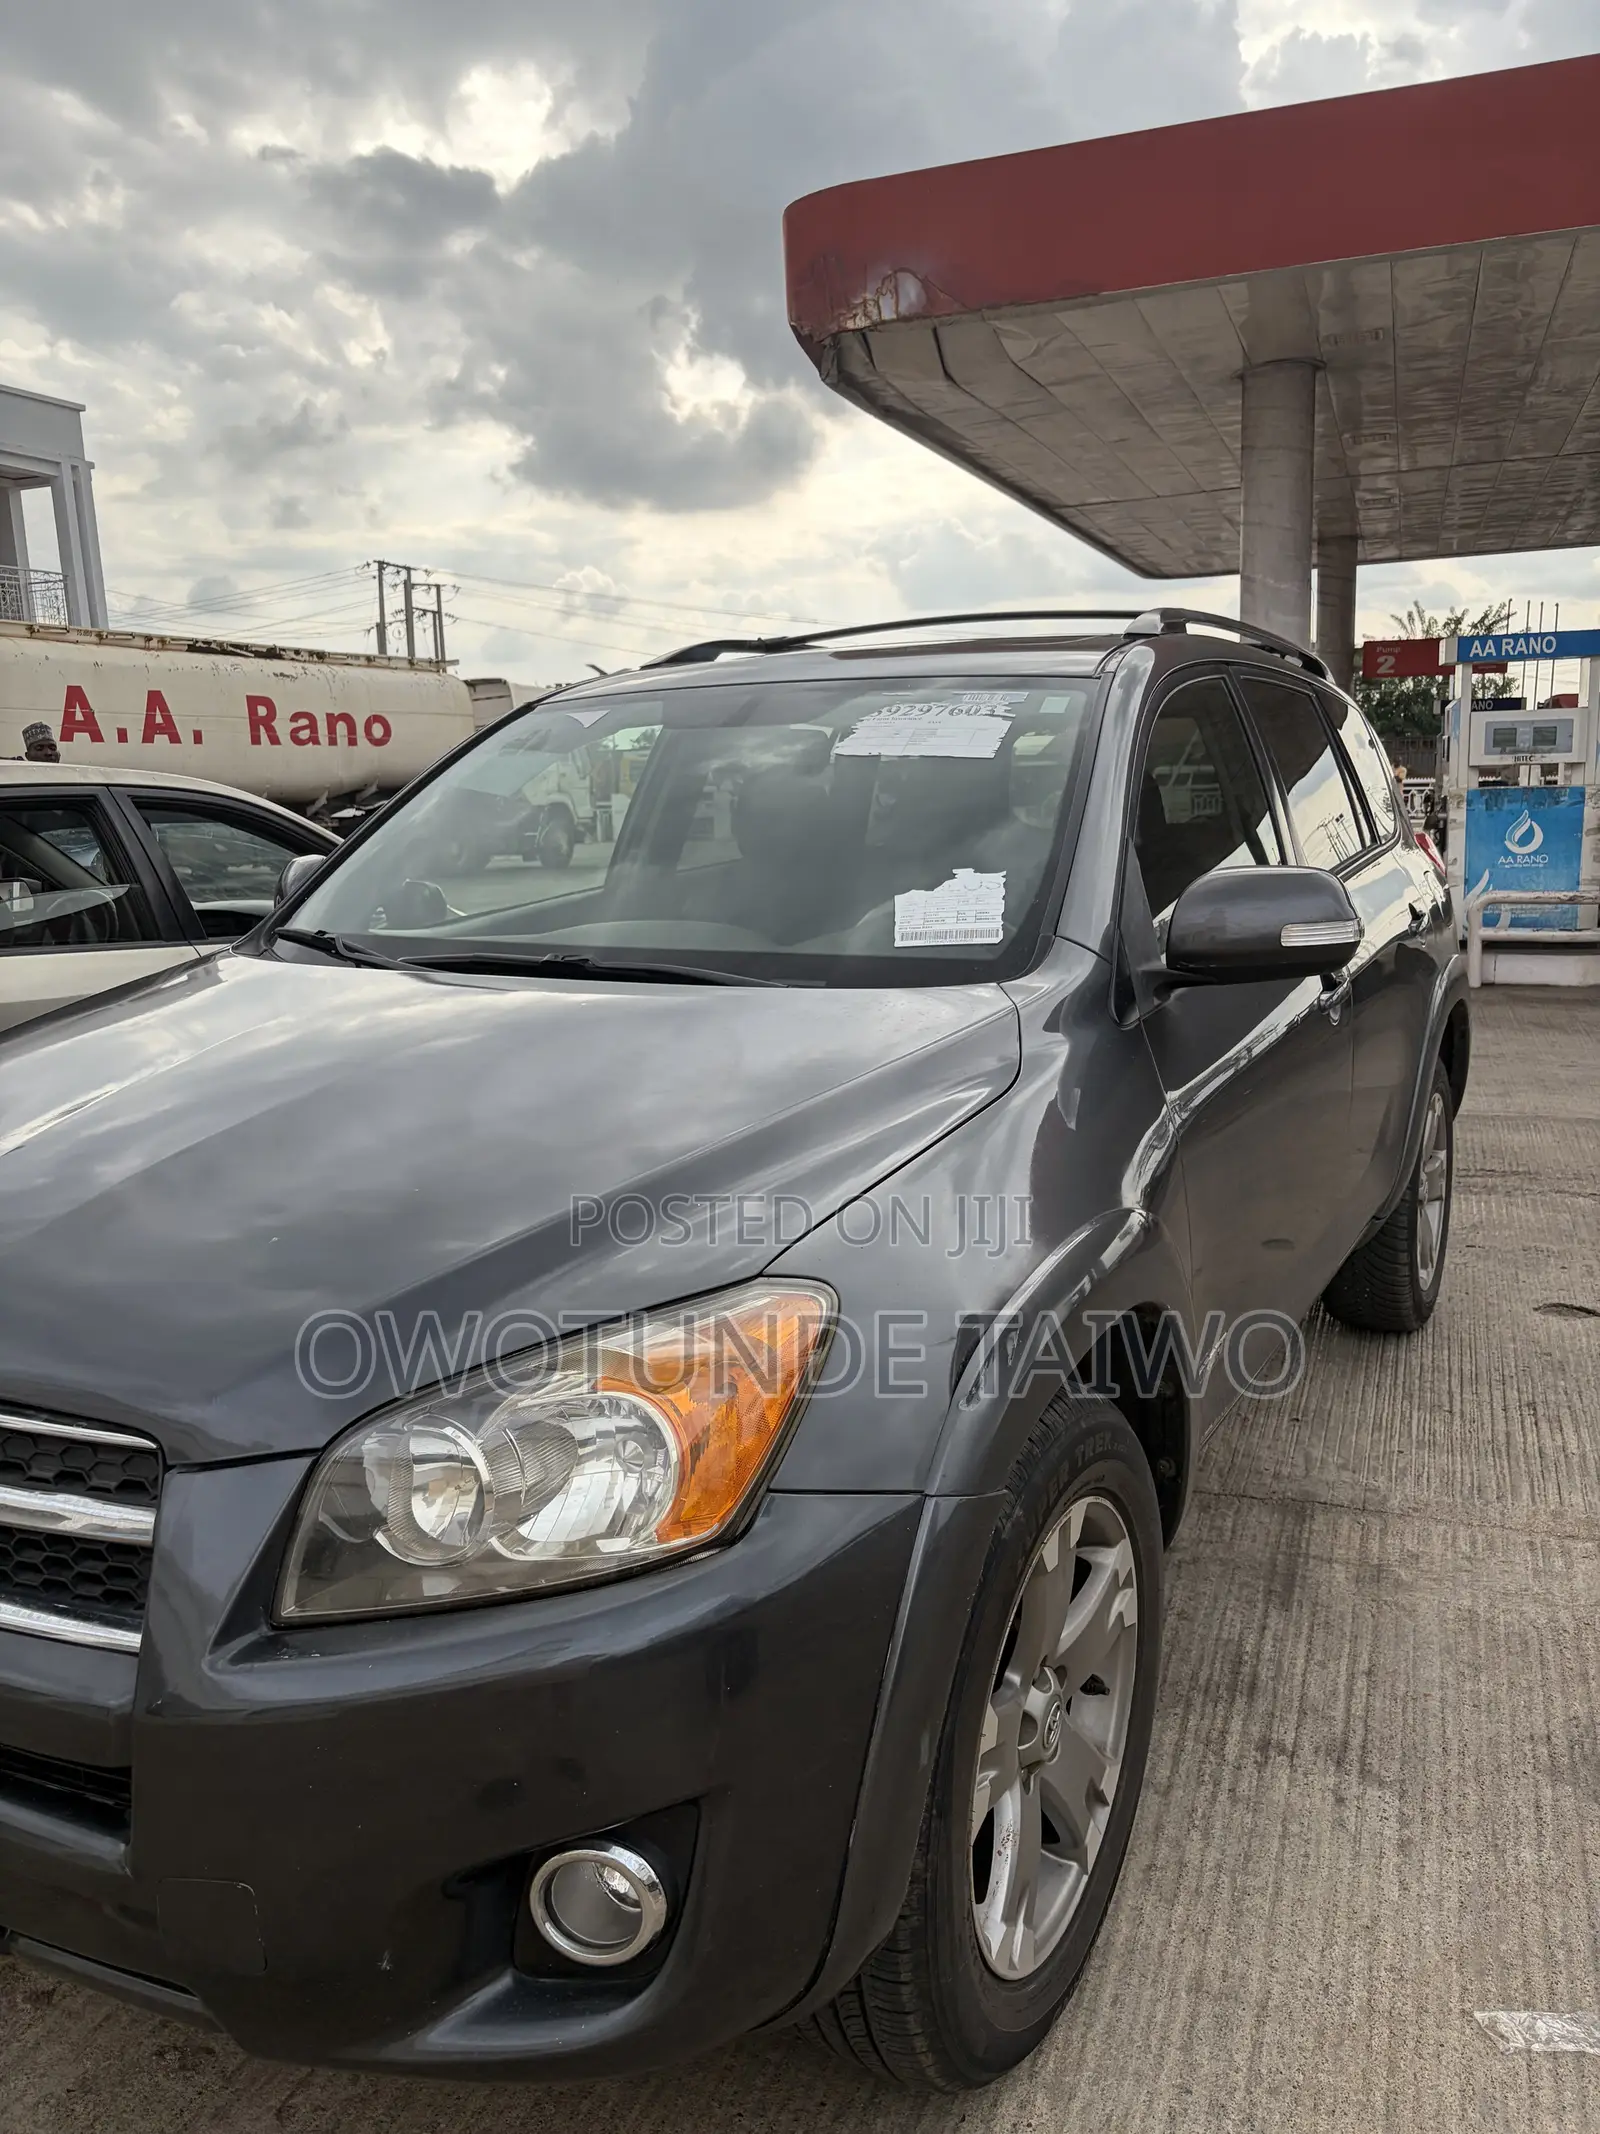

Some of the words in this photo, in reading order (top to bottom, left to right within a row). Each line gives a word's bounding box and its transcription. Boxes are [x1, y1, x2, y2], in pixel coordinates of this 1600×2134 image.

[1469, 639, 1497, 657] AA
[1501, 635, 1557, 656] RANO
[1376, 655, 1396, 674] 2
[1471, 700, 1494, 711] ANO
[59, 684, 204, 745] A.A.
[245, 693, 393, 748] Rano
[1498, 855, 1514, 865] AA
[1516, 854, 1549, 864] RANO
